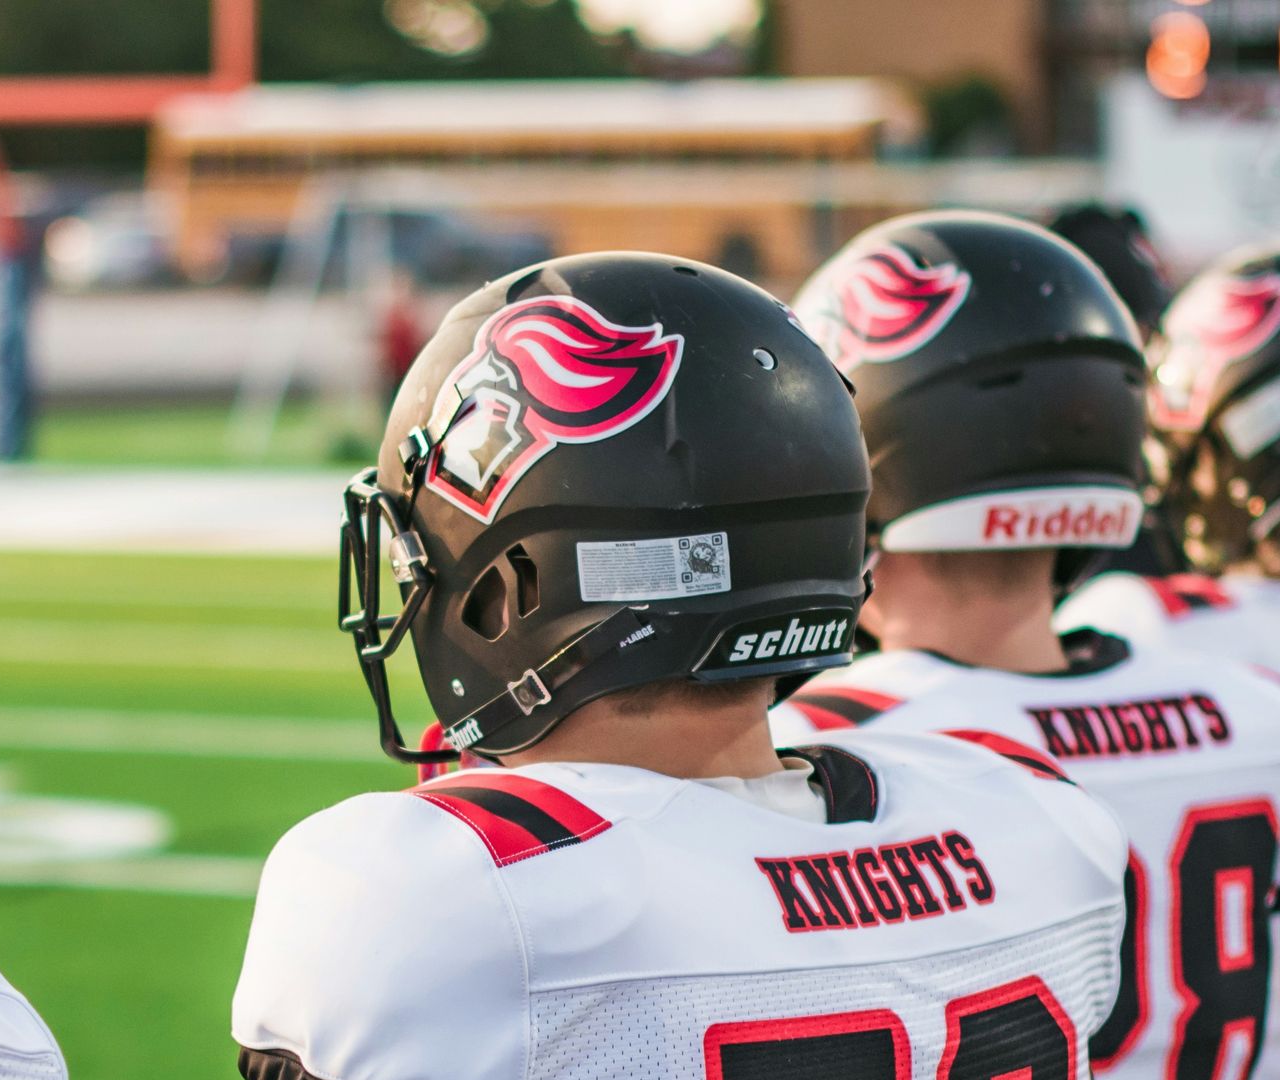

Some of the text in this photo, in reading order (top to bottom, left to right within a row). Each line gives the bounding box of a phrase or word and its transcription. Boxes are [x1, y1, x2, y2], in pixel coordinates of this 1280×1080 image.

[729, 617, 848, 662] schutt
[1025, 692, 1231, 761] KNIGHTS
[755, 829, 997, 934] KNIGHTS
